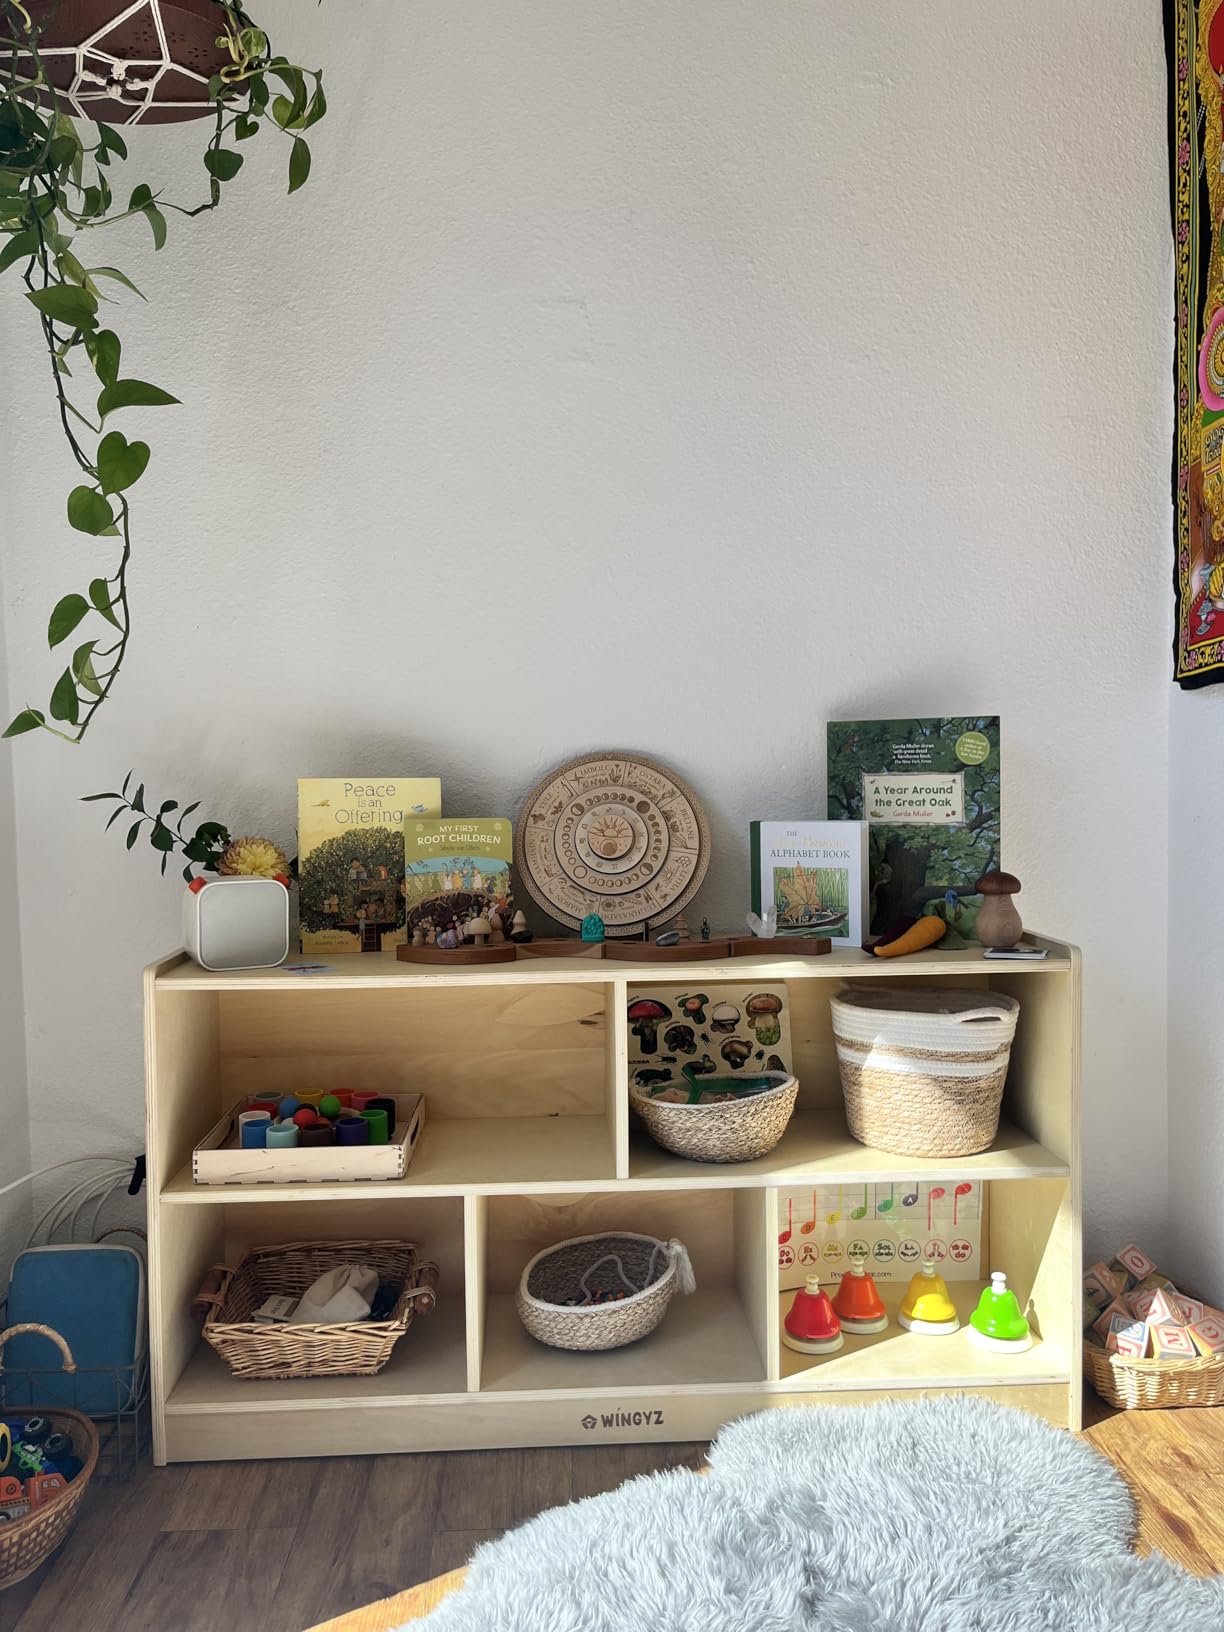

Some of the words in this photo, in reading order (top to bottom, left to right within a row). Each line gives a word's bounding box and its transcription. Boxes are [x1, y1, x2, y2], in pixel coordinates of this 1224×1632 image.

[344, 782, 396, 797] Peace
[874, 786, 880, 794] A
[884, 786, 909, 795] Year
[912, 785, 953, 794] Around
[358, 798, 366, 808] is
[368, 800, 382, 808] an
[875, 798, 892, 806] the
[896, 798, 926, 806] Great
[929, 798, 952, 806] Oak
[334, 808, 404, 824] Offering
[455, 824, 479, 832] FIRST
[417, 834, 446, 845] ROOT
[448, 834, 501, 844] CHILDREN
[770, 849, 820, 858] ALPHABET
[823, 850, 851, 858] BOOK
